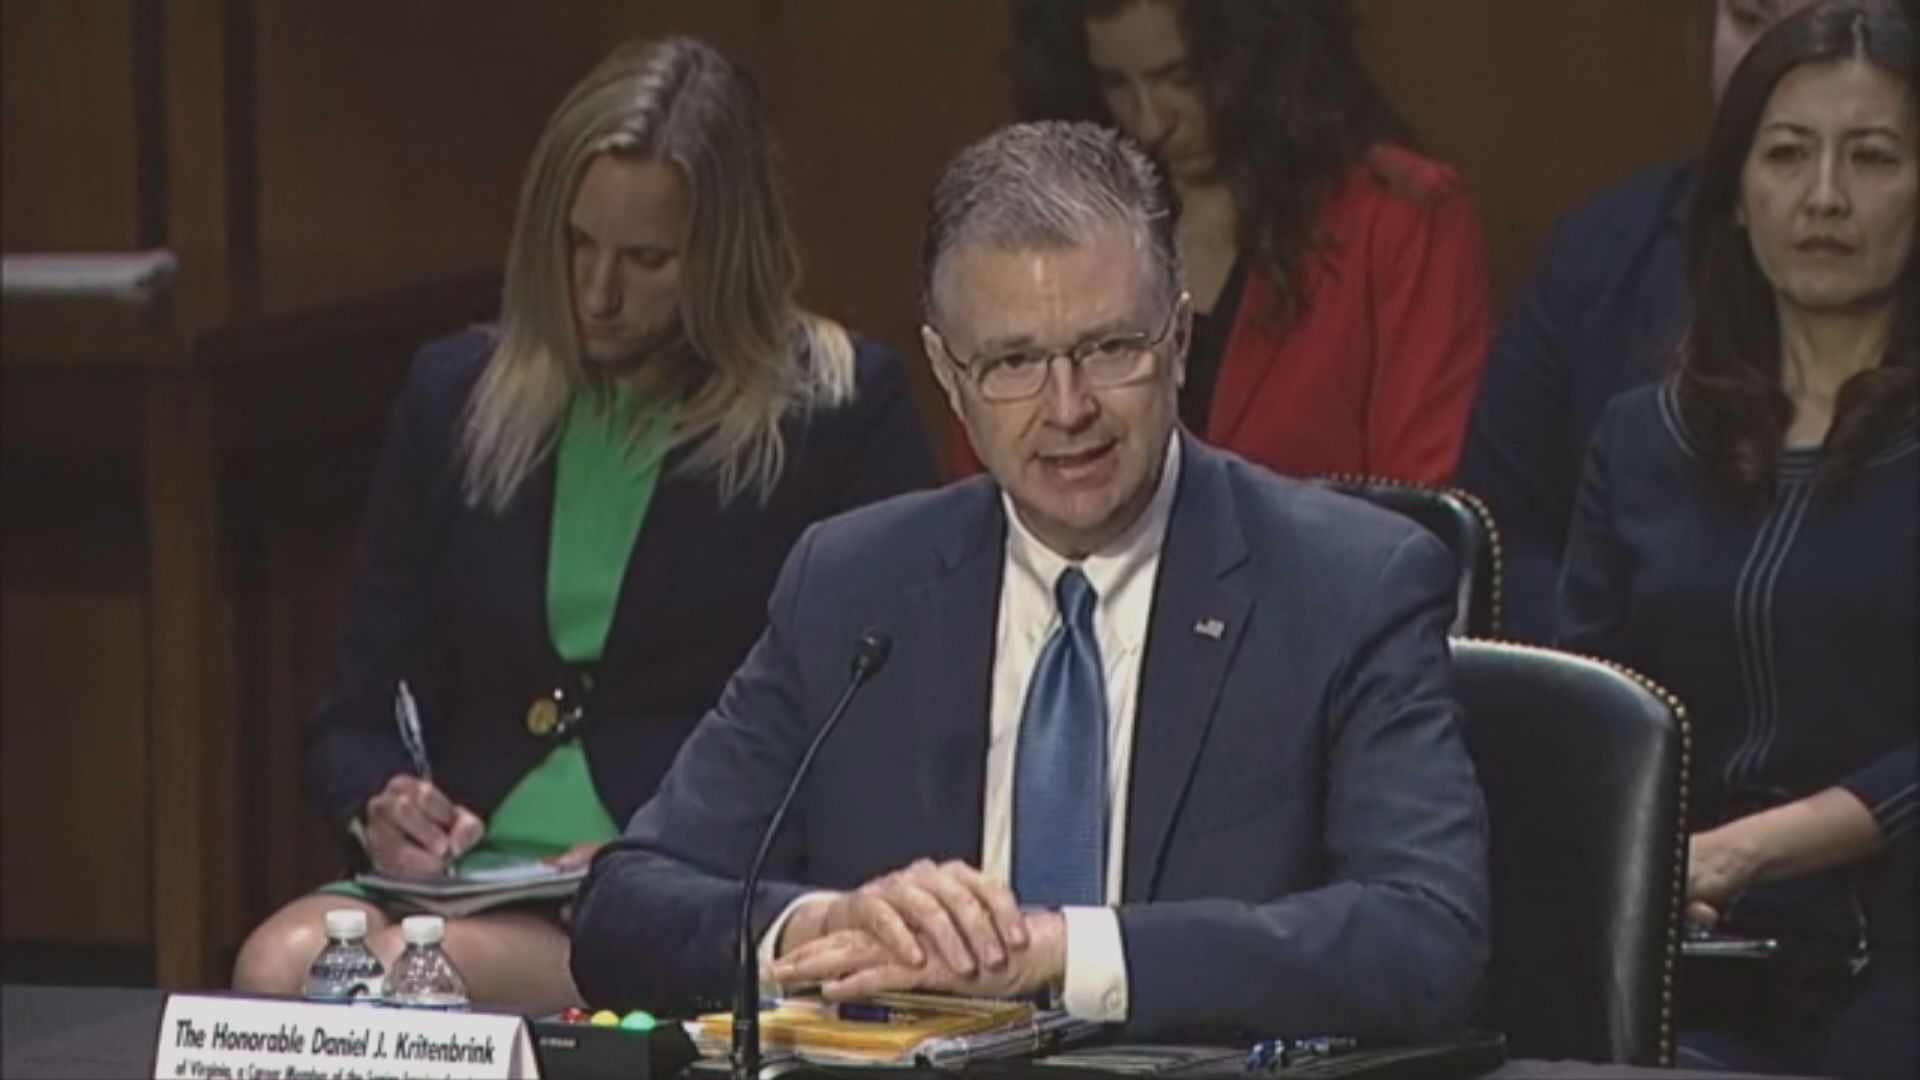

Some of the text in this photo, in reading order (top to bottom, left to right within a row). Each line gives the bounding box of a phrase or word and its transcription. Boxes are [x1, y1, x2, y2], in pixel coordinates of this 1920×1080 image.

[176, 1019, 496, 1065] The Honorable Daniel J. Kritenbrink
